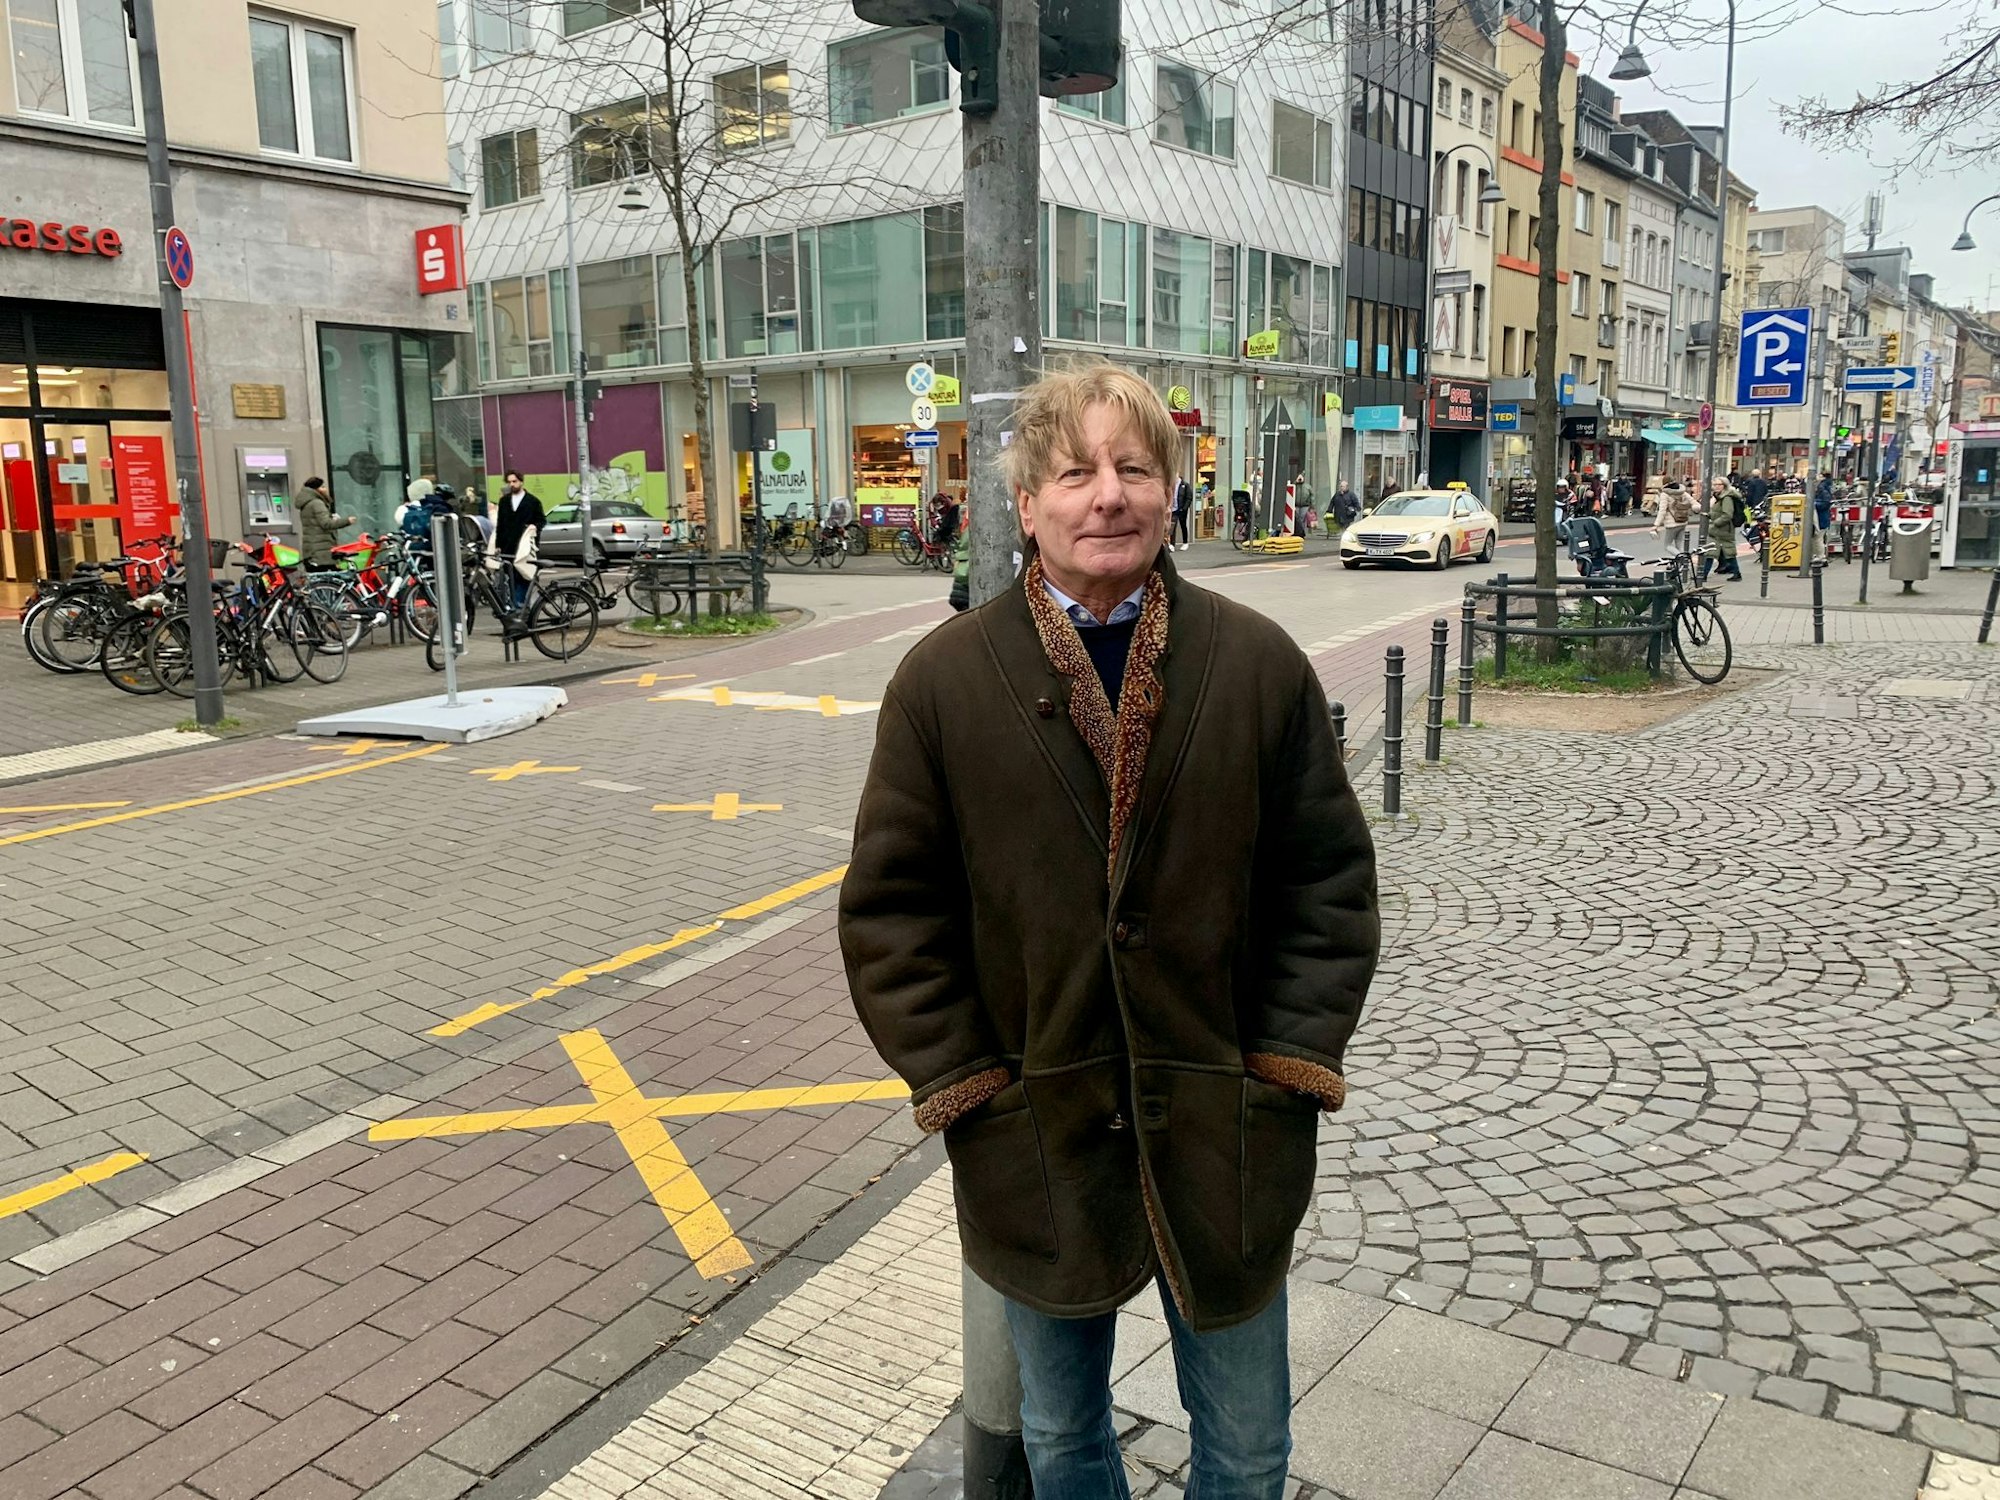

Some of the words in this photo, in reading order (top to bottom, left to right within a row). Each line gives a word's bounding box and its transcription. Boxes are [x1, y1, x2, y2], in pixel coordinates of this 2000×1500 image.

[1754, 331, 1790, 377] P
[1450, 388, 1471, 404] SPIEL
[917, 406, 932, 420] 30
[1448, 405, 1472, 422] HALLE
[1494, 412, 1516, 422] TEDi
